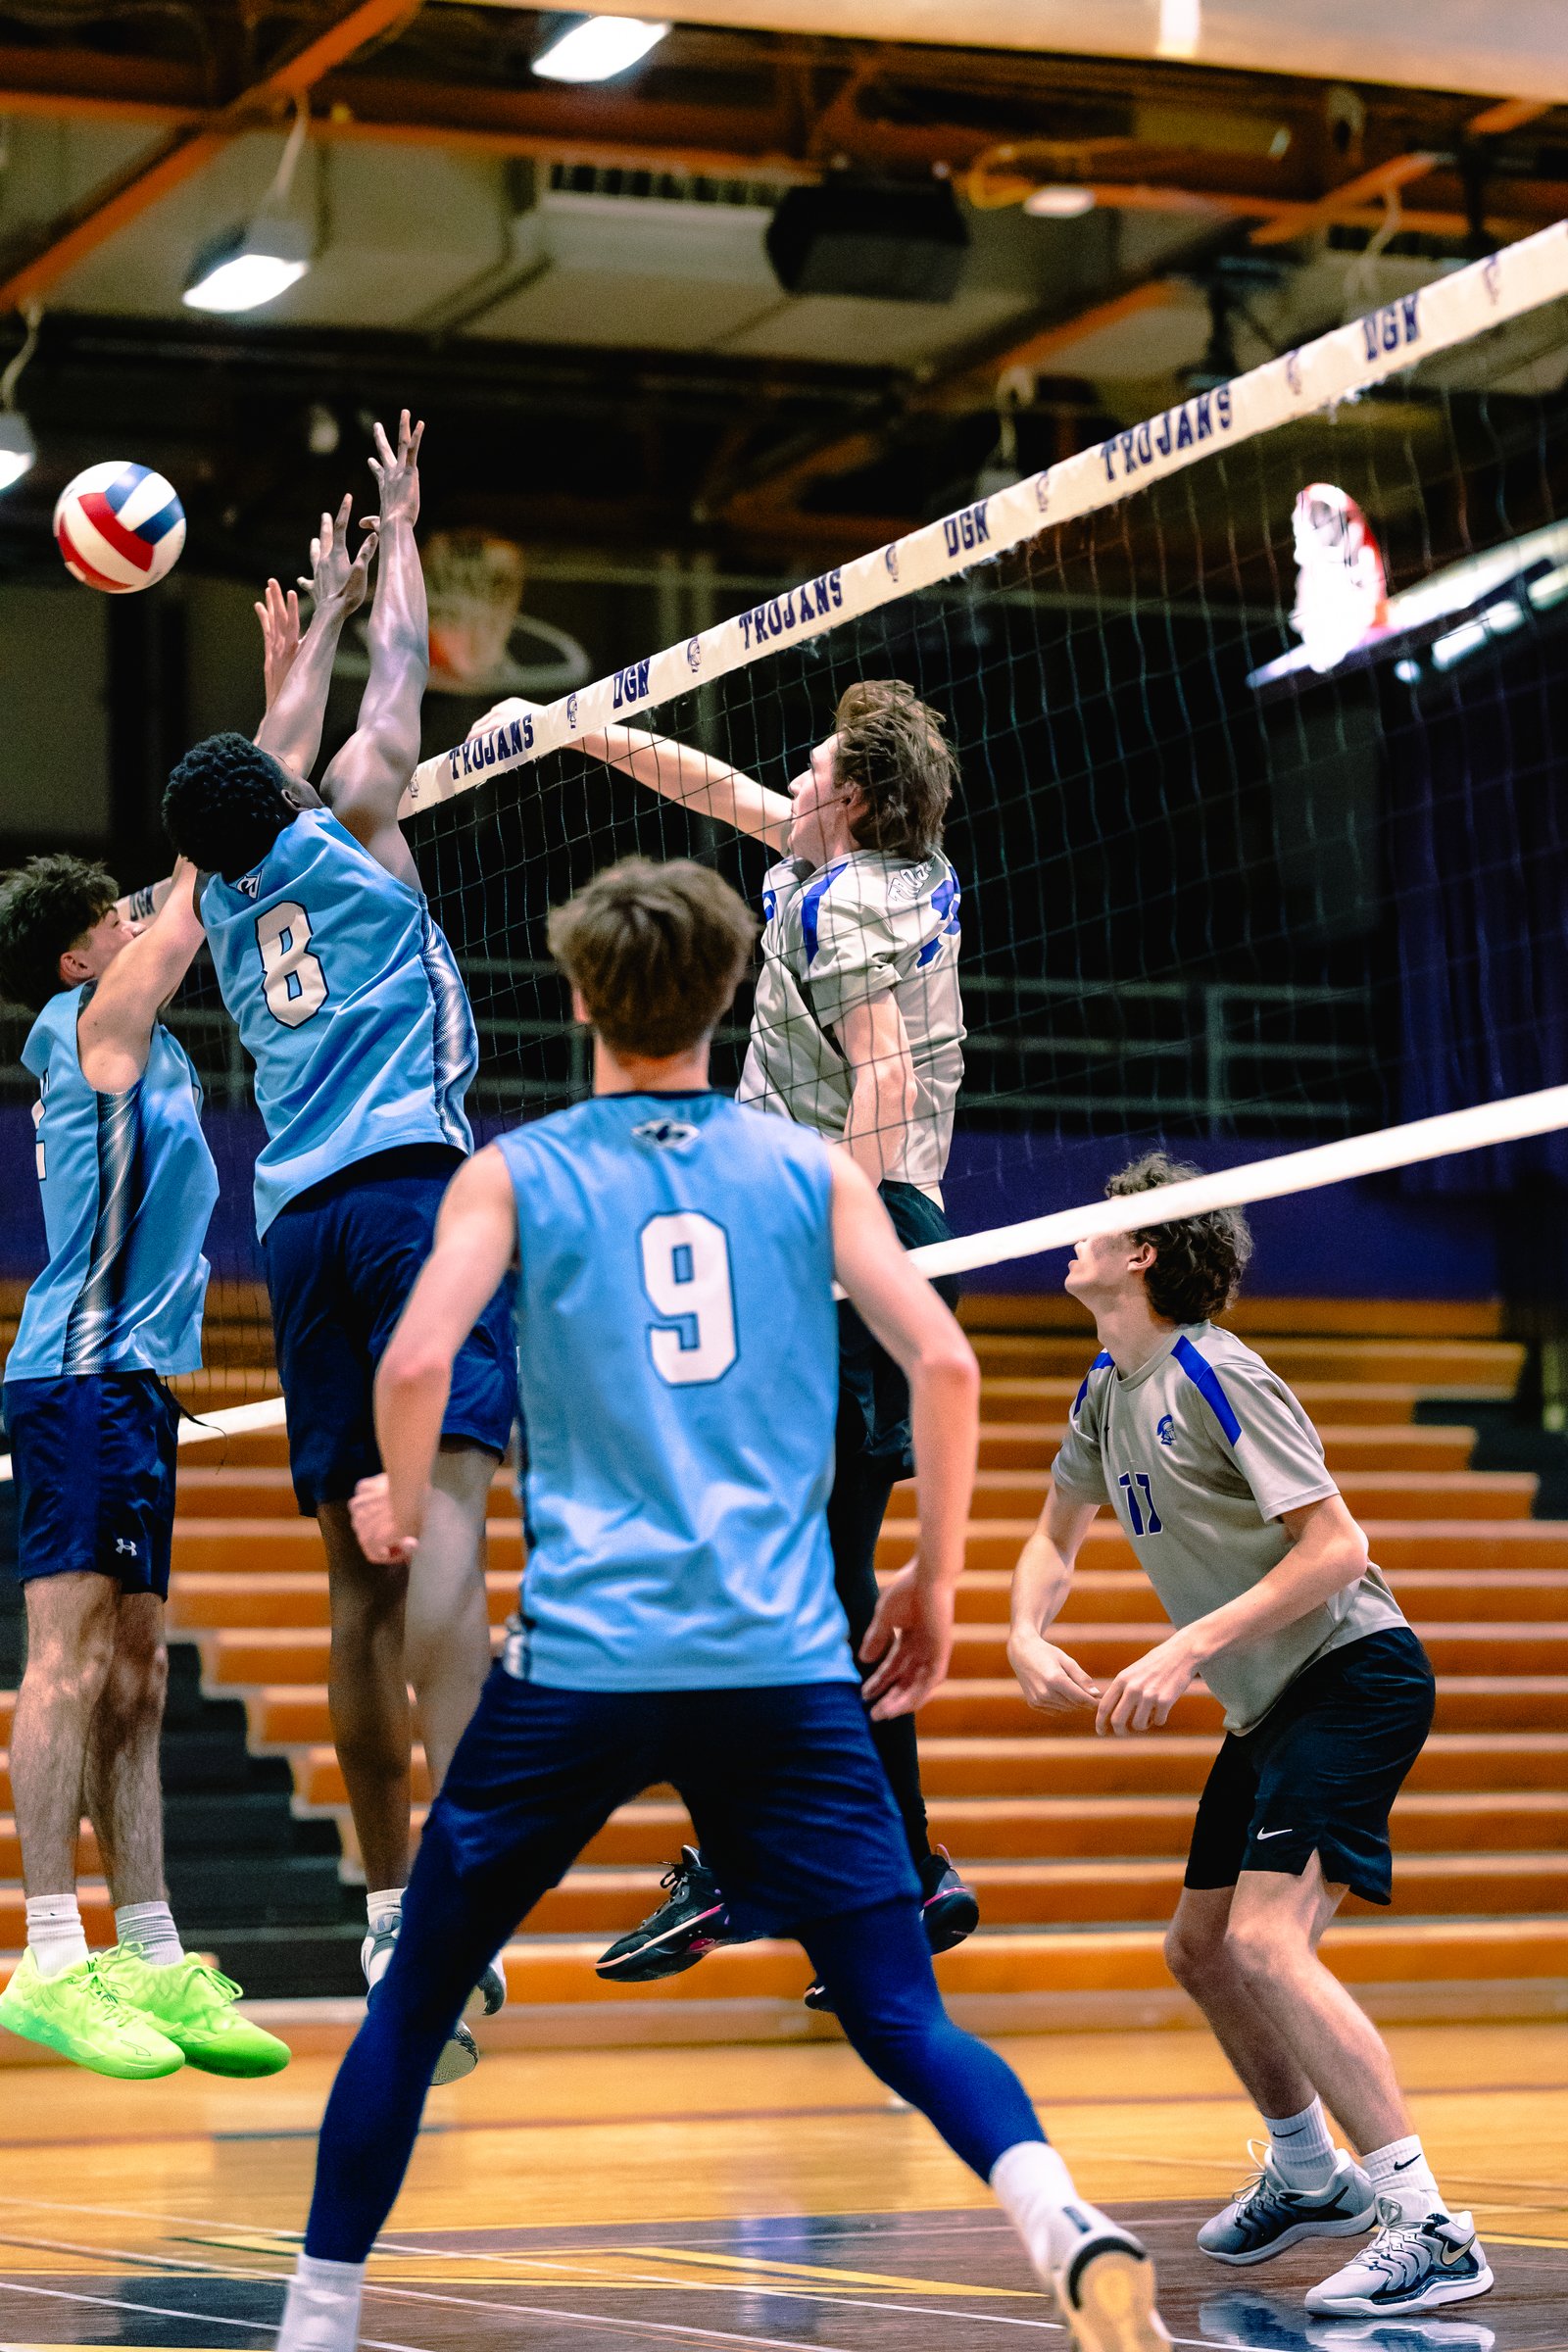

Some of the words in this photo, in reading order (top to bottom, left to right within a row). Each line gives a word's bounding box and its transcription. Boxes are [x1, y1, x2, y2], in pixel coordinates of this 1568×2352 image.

[449, 712, 534, 780] TROJANS
[612, 658, 651, 710] DGN
[738, 566, 844, 651] TROJANS
[943, 500, 991, 558] DGN
[1100, 383, 1233, 481] TROJANS
[254, 900, 330, 1030] 8
[637, 1208, 741, 1388] 9
